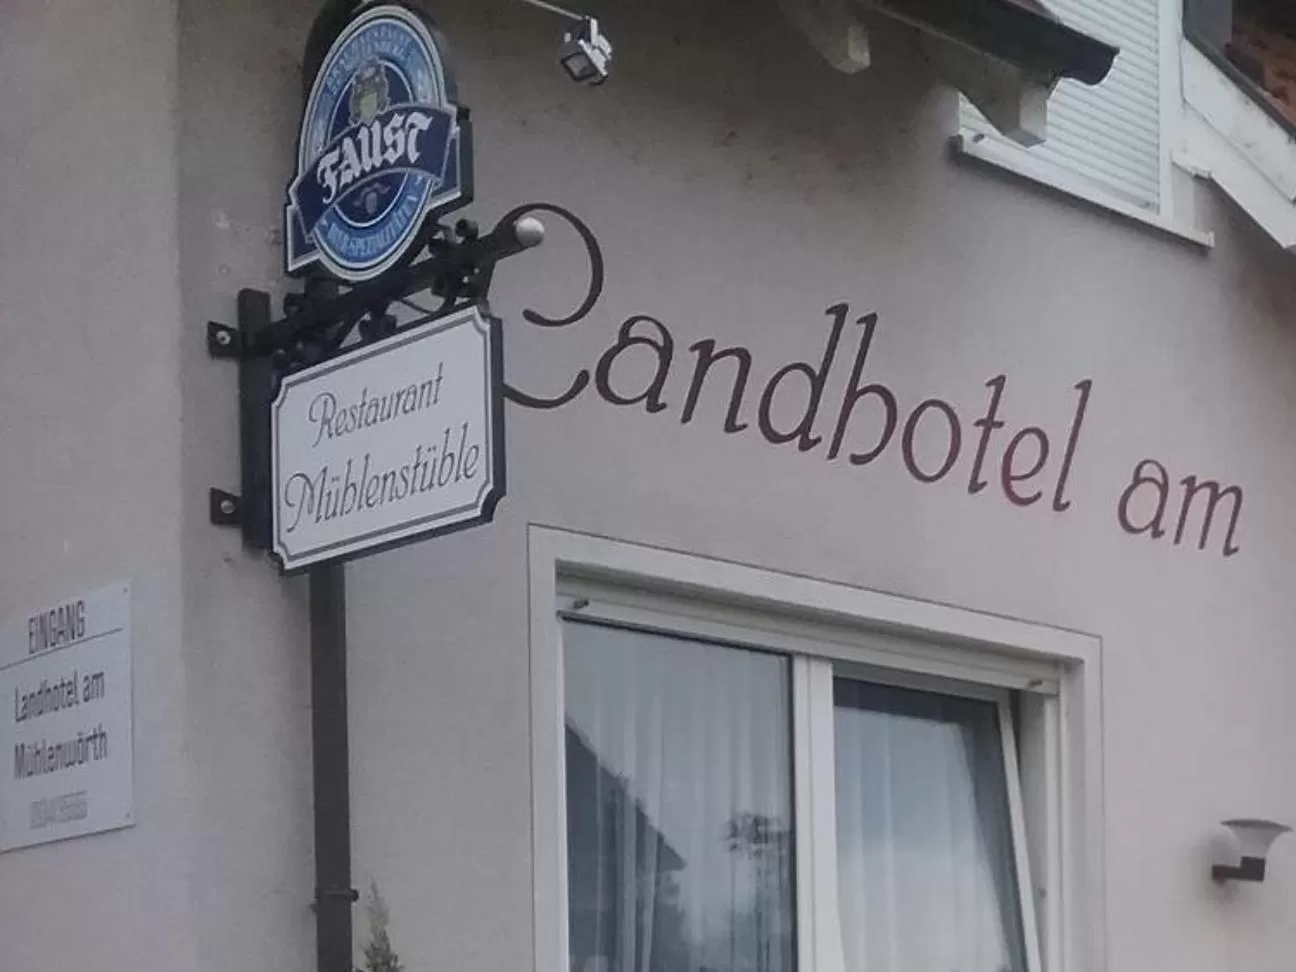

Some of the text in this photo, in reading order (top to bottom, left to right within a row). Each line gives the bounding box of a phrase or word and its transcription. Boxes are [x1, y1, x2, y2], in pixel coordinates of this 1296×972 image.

[316, 112, 434, 204] FAUST
[308, 361, 444, 448] Restaurant
[494, 203, 1092, 512] Landhotel
[1116, 458, 1244, 557] am
[285, 422, 480, 534] Mühlenstüble
[28, 600, 86, 655] EINGANG
[14, 669, 105, 723] Landhotel am
[13, 722, 108, 780] Mühlenwörth
